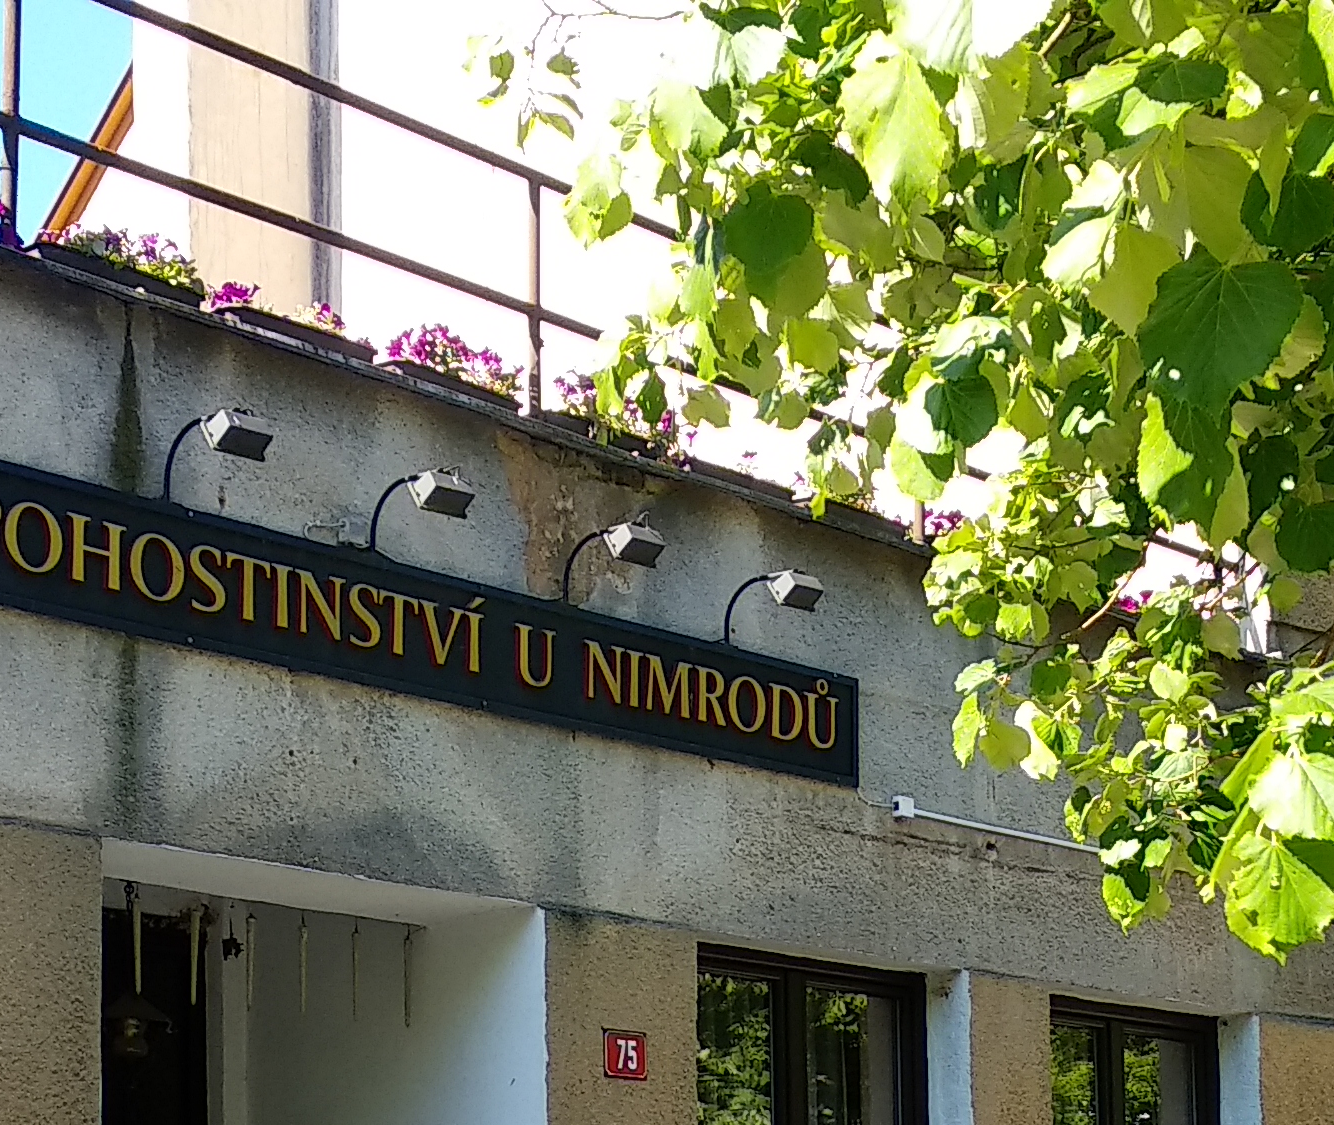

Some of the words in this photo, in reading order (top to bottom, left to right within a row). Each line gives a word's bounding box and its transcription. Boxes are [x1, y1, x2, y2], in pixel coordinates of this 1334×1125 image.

[513, 623, 556, 688] U
[585, 639, 840, 750] NIMRODŮ
[616, 1038, 638, 1070] 75
